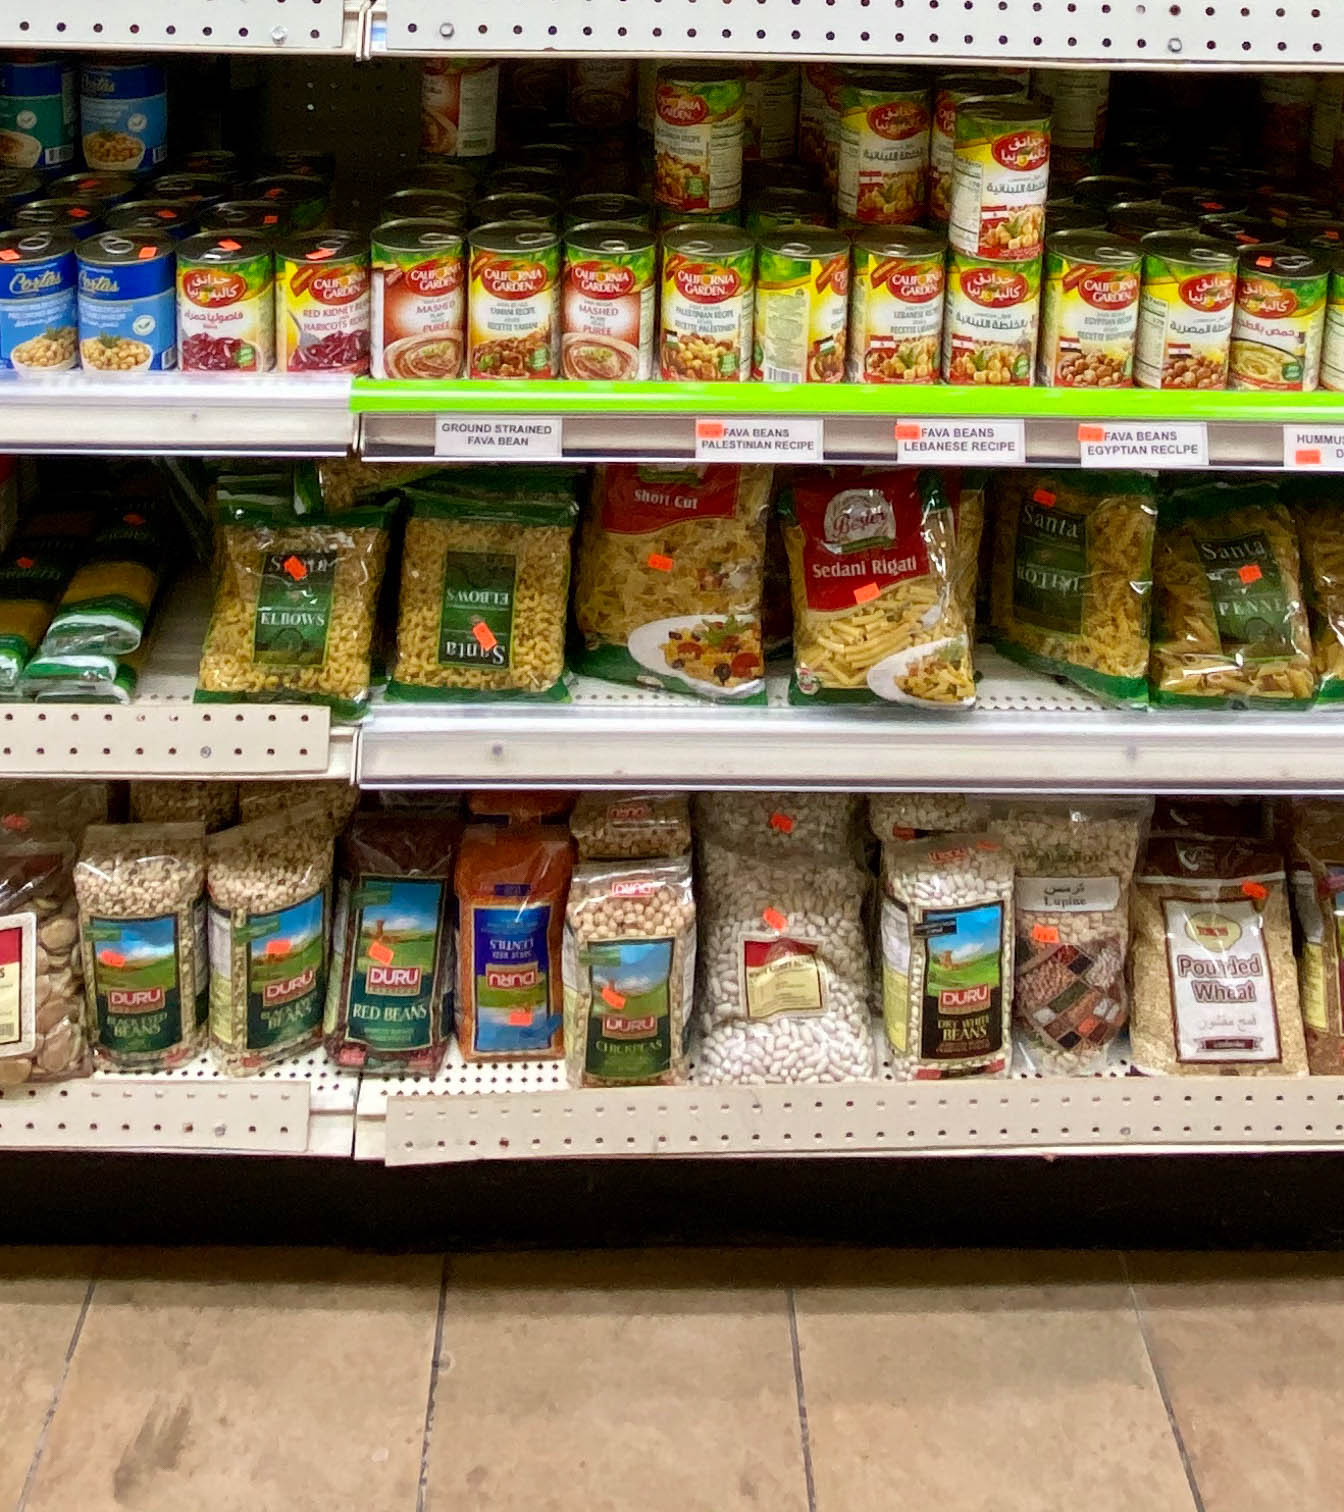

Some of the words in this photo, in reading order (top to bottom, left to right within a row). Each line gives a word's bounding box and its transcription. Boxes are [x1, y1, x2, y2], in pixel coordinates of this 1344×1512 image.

[9, 271, 63, 295] Cortas
[492, 279, 536, 292] GARDEN
[580, 279, 623, 292] GARDEN
[684, 283, 728, 298] GARDEN
[415, 300, 457, 315] MASHED
[441, 422, 492, 435] GROUND
[494, 423, 553, 436] STRAINED
[722, 427, 751, 438] FAVA
[752, 427, 790, 439] BEANS
[921, 427, 951, 439] FAVA
[953, 428, 995, 439] BEANS
[1103, 431, 1133, 443] FAVA
[1135, 431, 1178, 443] BEANS
[467, 436, 495, 447] FAVA
[497, 436, 530, 447] BEAN
[701, 439, 773, 451] PALESTINIAN
[774, 439, 815, 451] RECIPE
[903, 441, 970, 452] LEBANESE
[972, 441, 1016, 452] RECIPE
[1087, 444, 1148, 456] EGYPTIAN
[634, 487, 671, 507] Short
[673, 493, 698, 510] Cut
[1022, 502, 1080, 539] Santa
[1200, 539, 1265, 561] Santa
[812, 559, 868, 579] Sedani
[871, 555, 918, 576] Rigati
[446, 589, 510, 607] ELBOWS
[260, 610, 326, 627] ELBOWS
[1176, 954, 1263, 979] Pounded
[265, 969, 315, 999] DURU
[370, 968, 420, 986] DURU
[488, 971, 536, 987] DURU
[110, 989, 162, 1007] DURU
[941, 986, 989, 1006] DURU
[1190, 979, 1258, 1004] Wheat
[352, 1003, 383, 1020] RED
[383, 1002, 428, 1022] BEANS
[605, 1016, 657, 1034] DURU
[942, 1026, 988, 1041] BEANS
